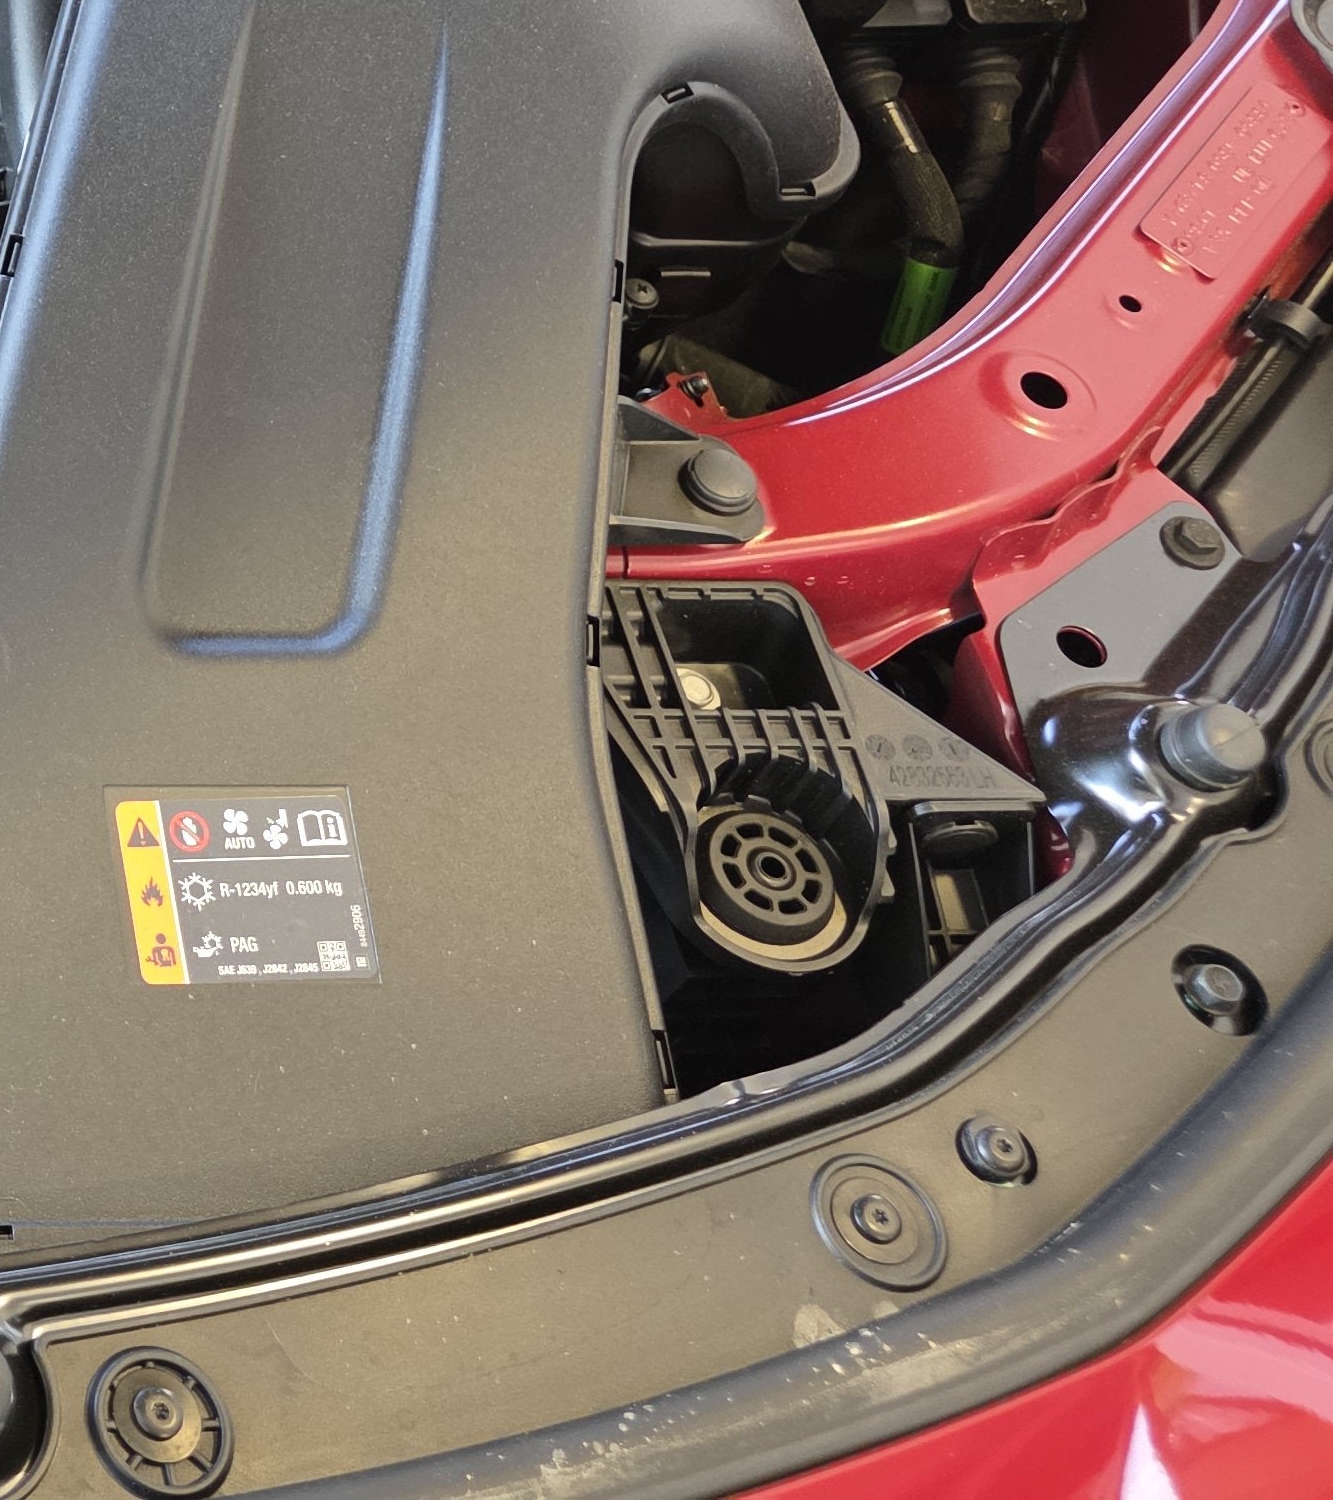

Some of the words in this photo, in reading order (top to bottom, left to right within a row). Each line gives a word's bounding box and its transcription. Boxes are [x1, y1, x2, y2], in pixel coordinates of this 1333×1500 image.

[224, 837, 255, 850] AUTO
[219, 881, 278, 898] R-1234yf
[286, 879, 323, 896] 0.600
[325, 879, 342, 897] kg
[230, 937, 258, 953] PAG
[218, 965, 236, 975] SAE
